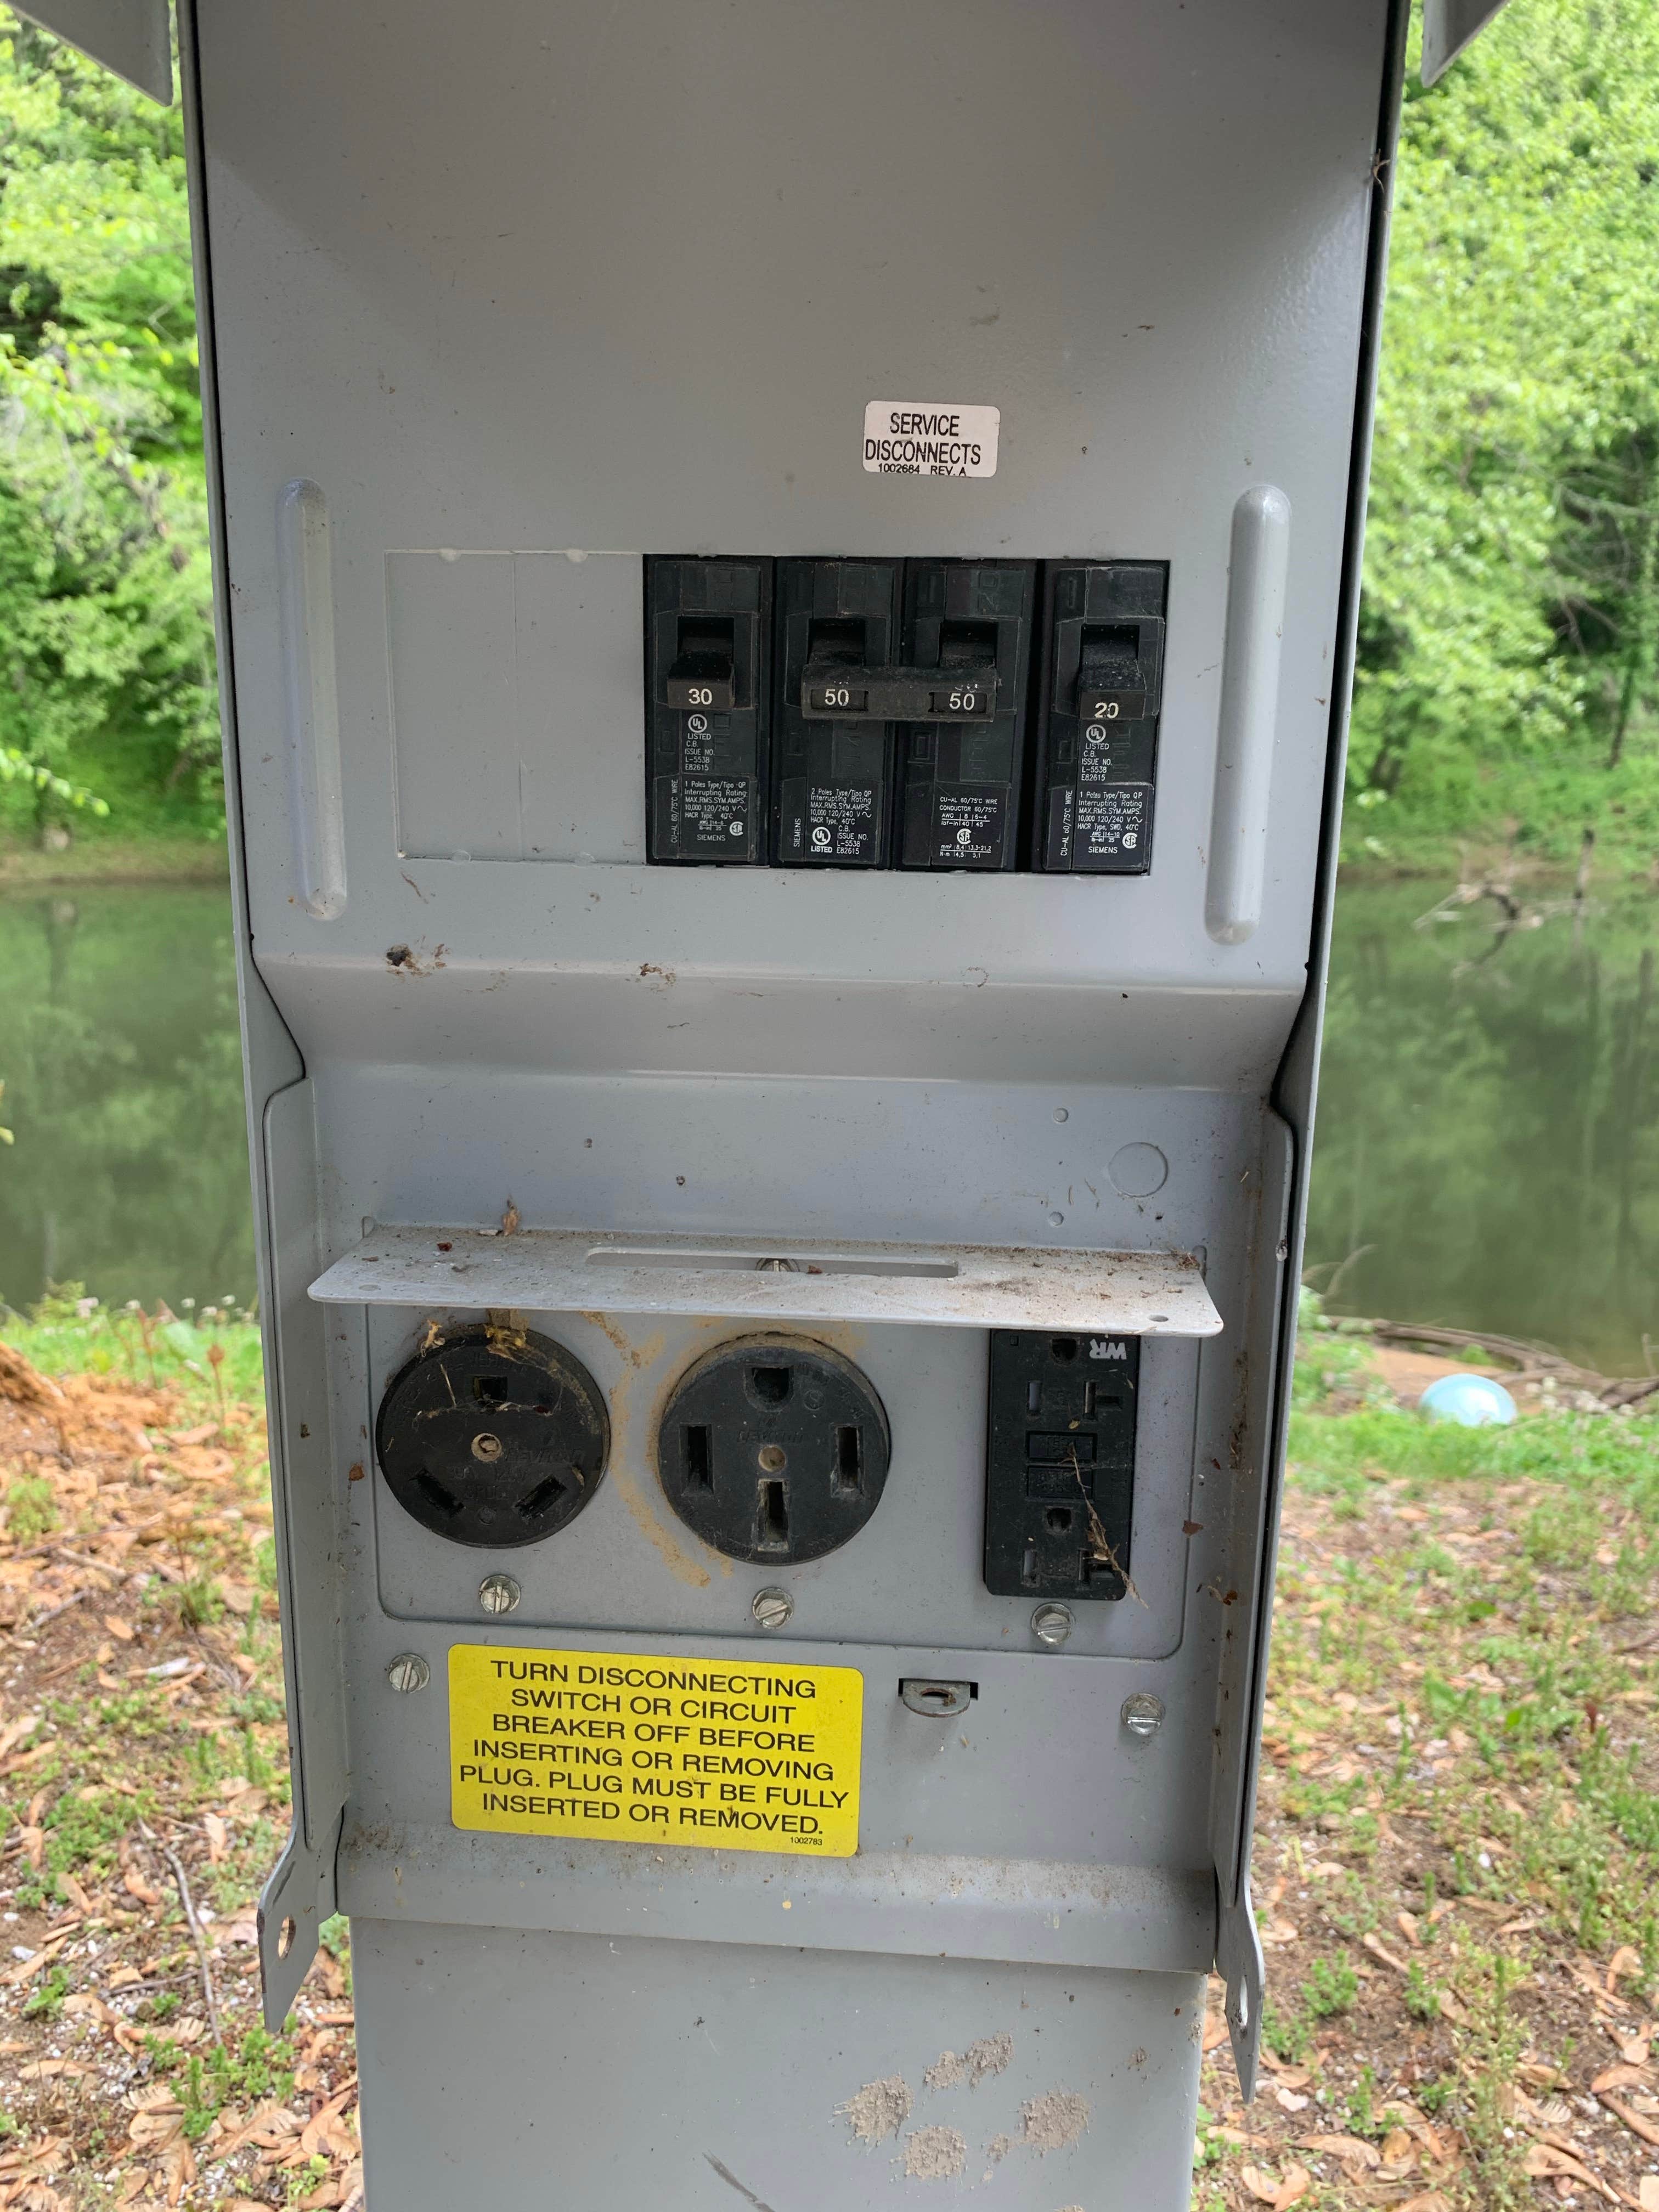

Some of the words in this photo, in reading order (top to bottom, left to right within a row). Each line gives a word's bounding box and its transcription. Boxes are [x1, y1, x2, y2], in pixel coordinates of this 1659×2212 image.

[890, 413, 960, 437] SERVICE
[865, 439, 981, 465] DISCONNECTS
[878, 463, 919, 474] 1002684
[930, 466, 956, 476] REV.
[959, 467, 967, 477] A
[689, 689, 712, 705] 30
[825, 689, 849, 707] 50
[949, 693, 975, 710] 50
[1094, 702, 1119, 719] 20
[851, 797, 871, 805] Rating
[1103, 791, 1130, 800] Type/Tipo
[829, 810, 853, 818] 120/240
[1060, 836, 1069, 856] CU-AL
[1090, 1339, 1127, 1359] WR
[490, 1660, 568, 1682] TURN
[578, 1666, 816, 1699] DISCONNECTING
[511, 1689, 620, 1713] SWITCH
[630, 1696, 672, 1716] OR
[681, 1700, 796, 1724] CIRCUIT
[493, 1714, 625, 1740] BREAKER
[634, 1723, 690, 1743] OFF
[699, 1728, 815, 1752] BEFORE
[474, 1740, 622, 1766] INSERTING
[631, 1751, 673, 1770] OR
[683, 1754, 833, 1781] REMOVING
[460, 1765, 540, 1787] PLUG.
[549, 1771, 622, 1793] PLUG
[633, 1778, 711, 1799] MUST
[720, 1784, 756, 1802] BE
[766, 1786, 849, 1808] FULLY
[483, 1793, 619, 1819] INSERTED
[629, 1804, 669, 1824] OR
[680, 1807, 823, 1834] REMOVED.
[790, 1837, 822, 1846] 1002783
